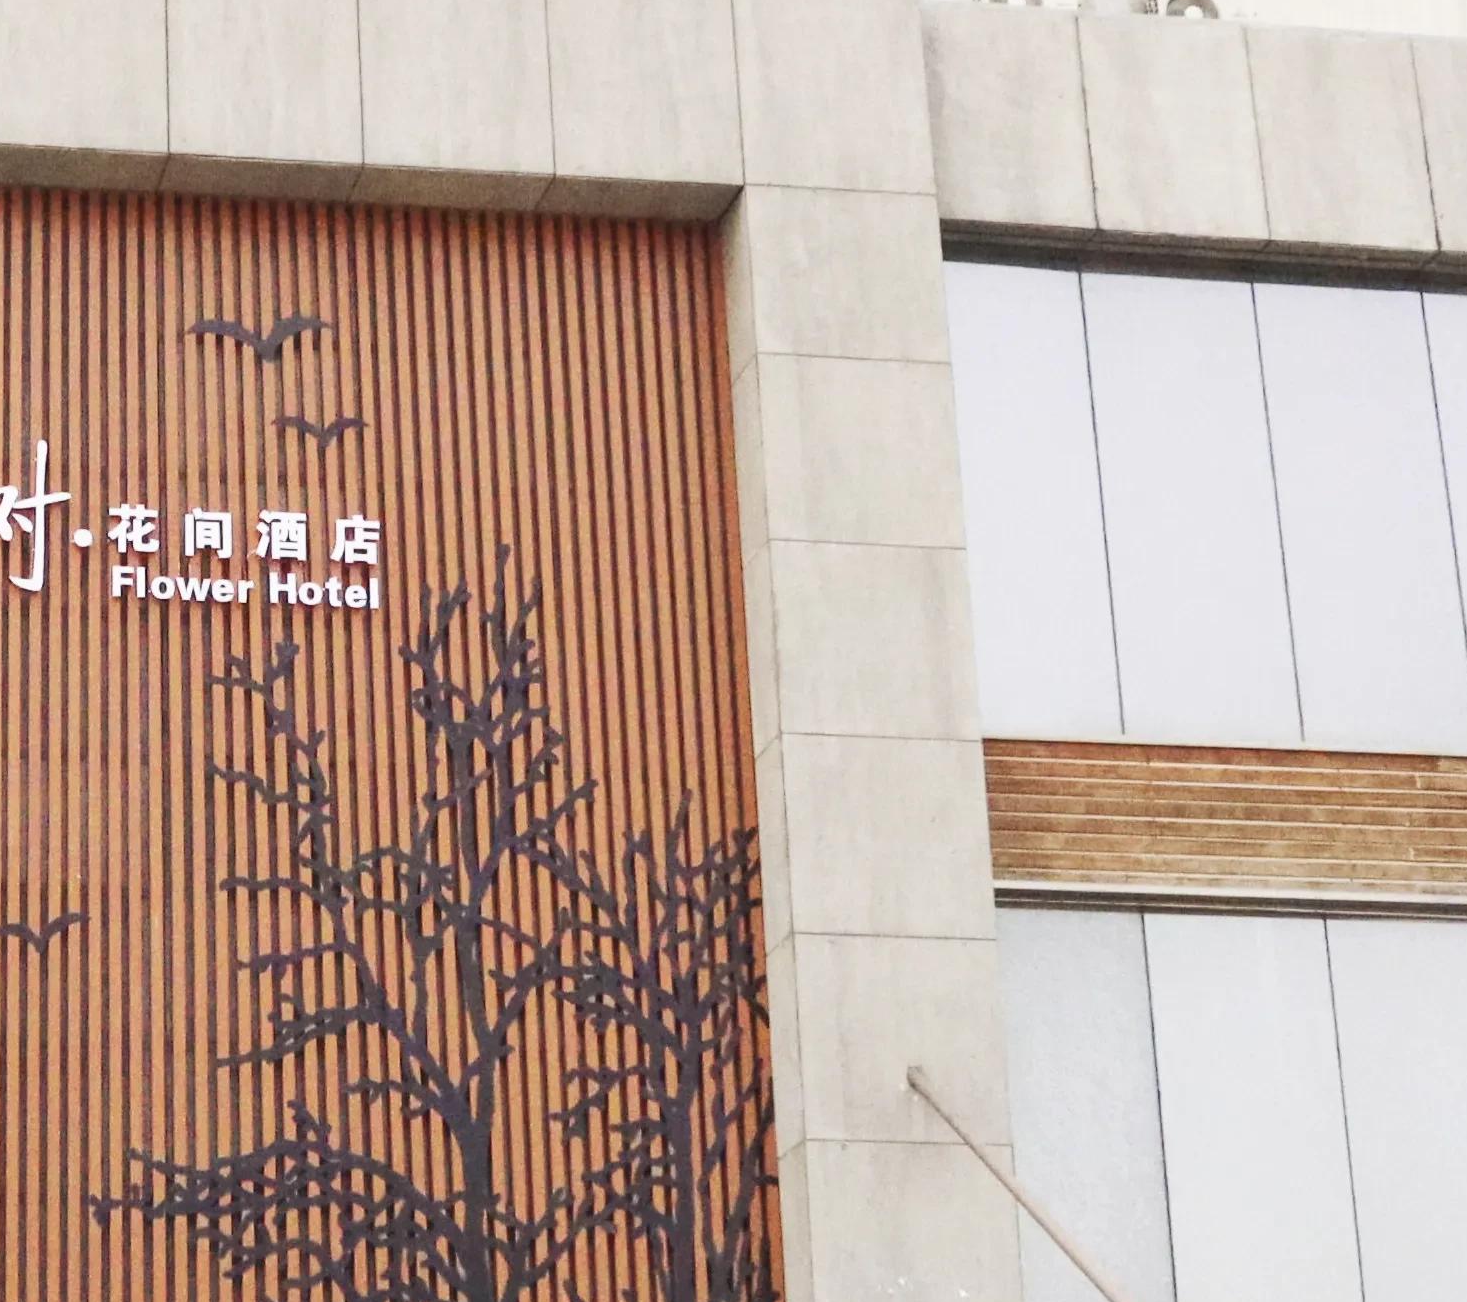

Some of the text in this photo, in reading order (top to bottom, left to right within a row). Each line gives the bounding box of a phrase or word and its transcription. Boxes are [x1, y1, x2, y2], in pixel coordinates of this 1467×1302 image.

[107, 504, 382, 566] 花间酒店
[111, 564, 381, 610] Flower Hotel
